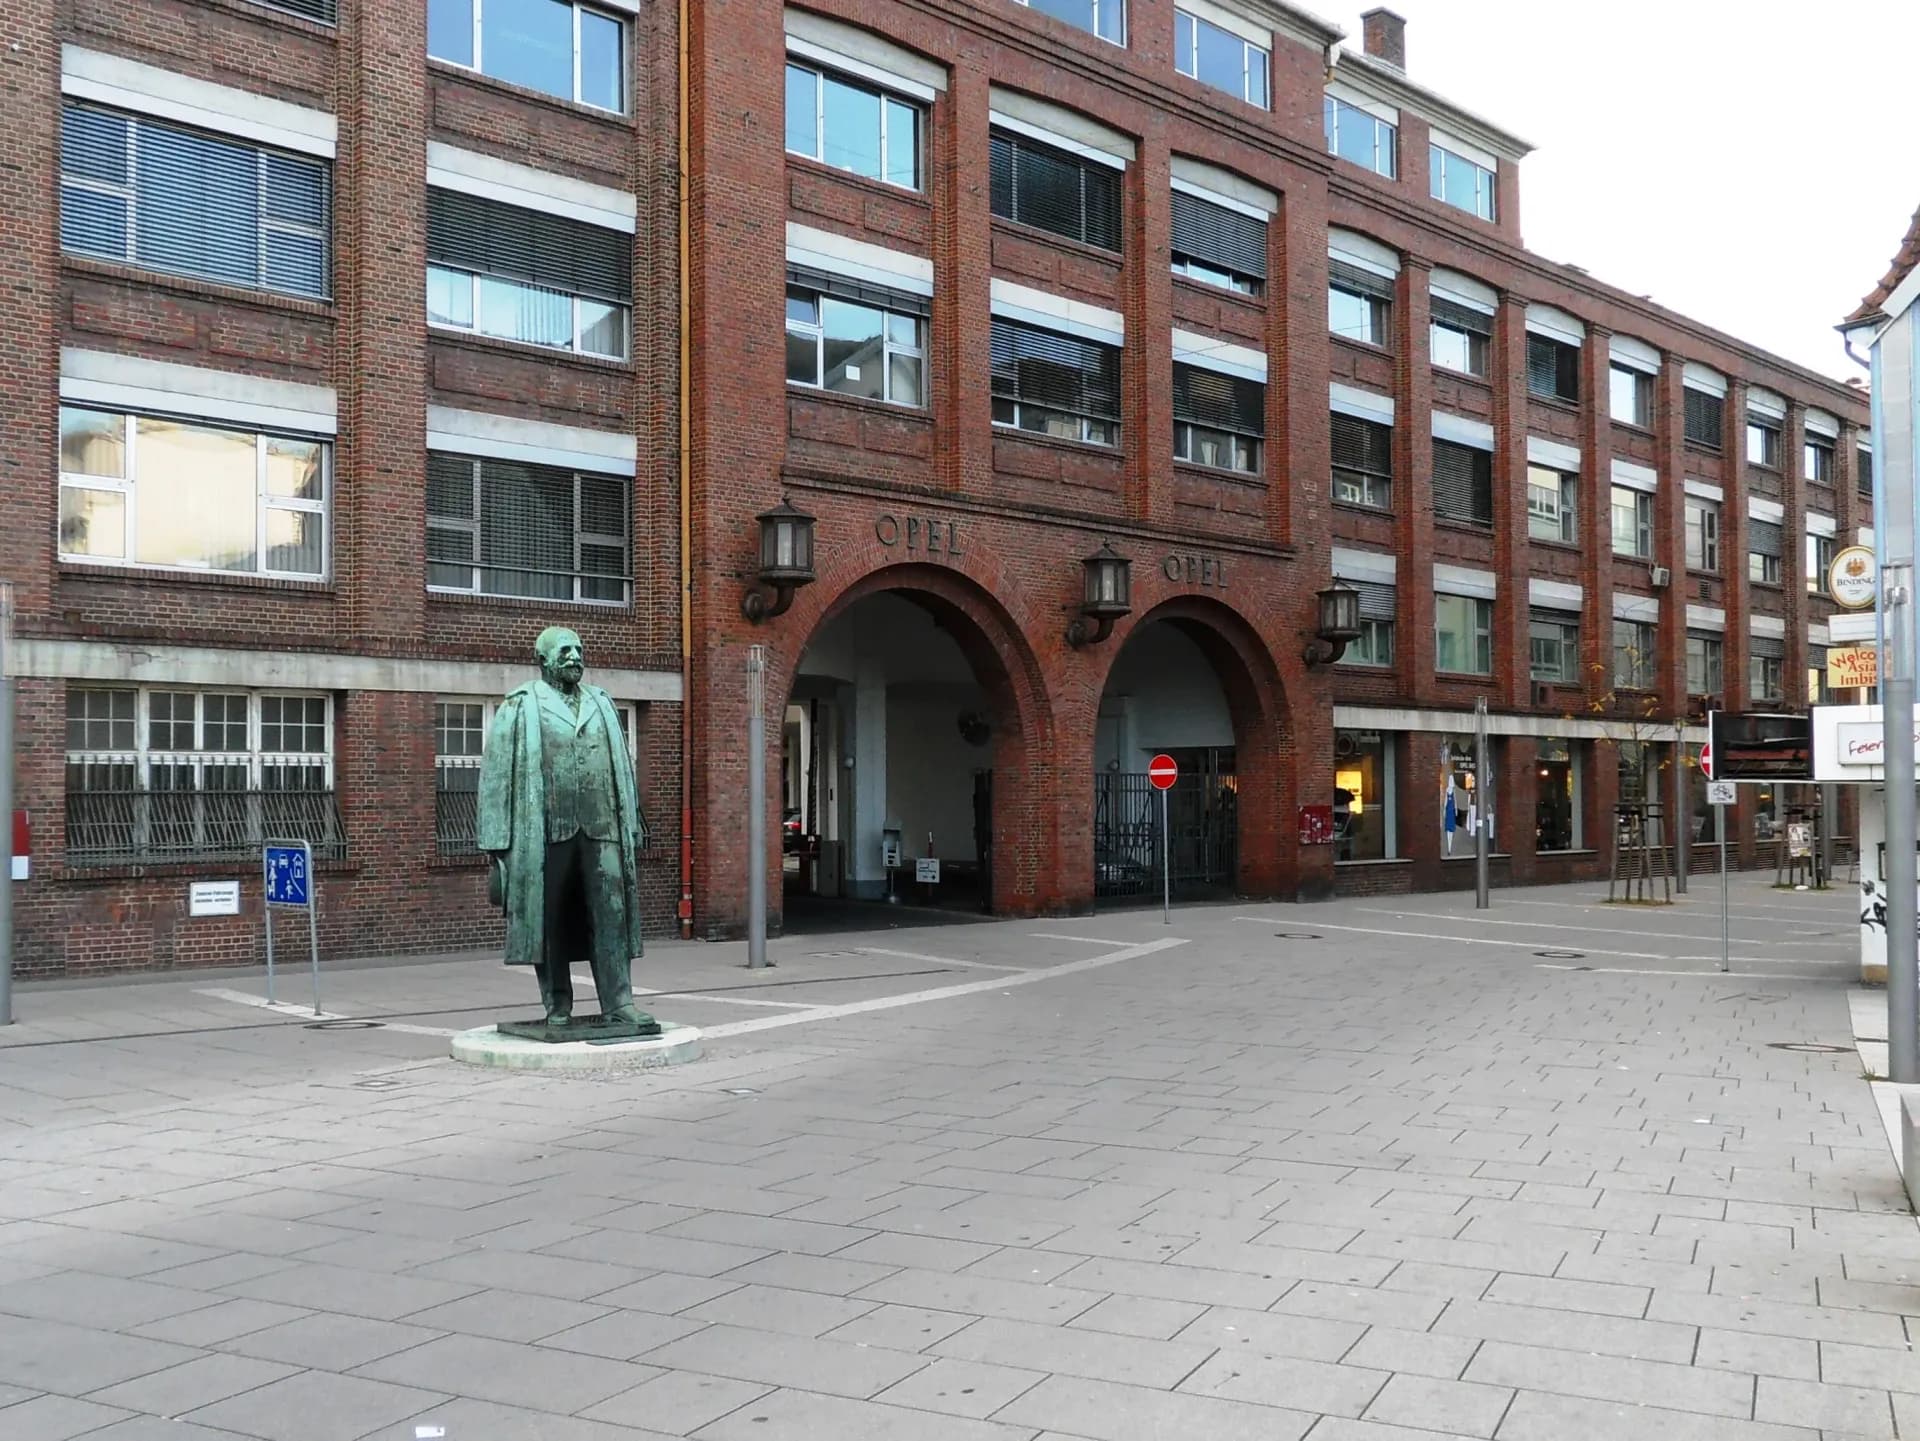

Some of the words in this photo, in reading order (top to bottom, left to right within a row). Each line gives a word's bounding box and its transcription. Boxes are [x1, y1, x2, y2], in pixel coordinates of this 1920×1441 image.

[876, 513, 962, 555] OPEL
[1163, 554, 1228, 588] OPEL
[1836, 577, 1876, 586] BINDING
[1829, 646, 1877, 669] Welco
[1840, 672, 1877, 686] Imbis
